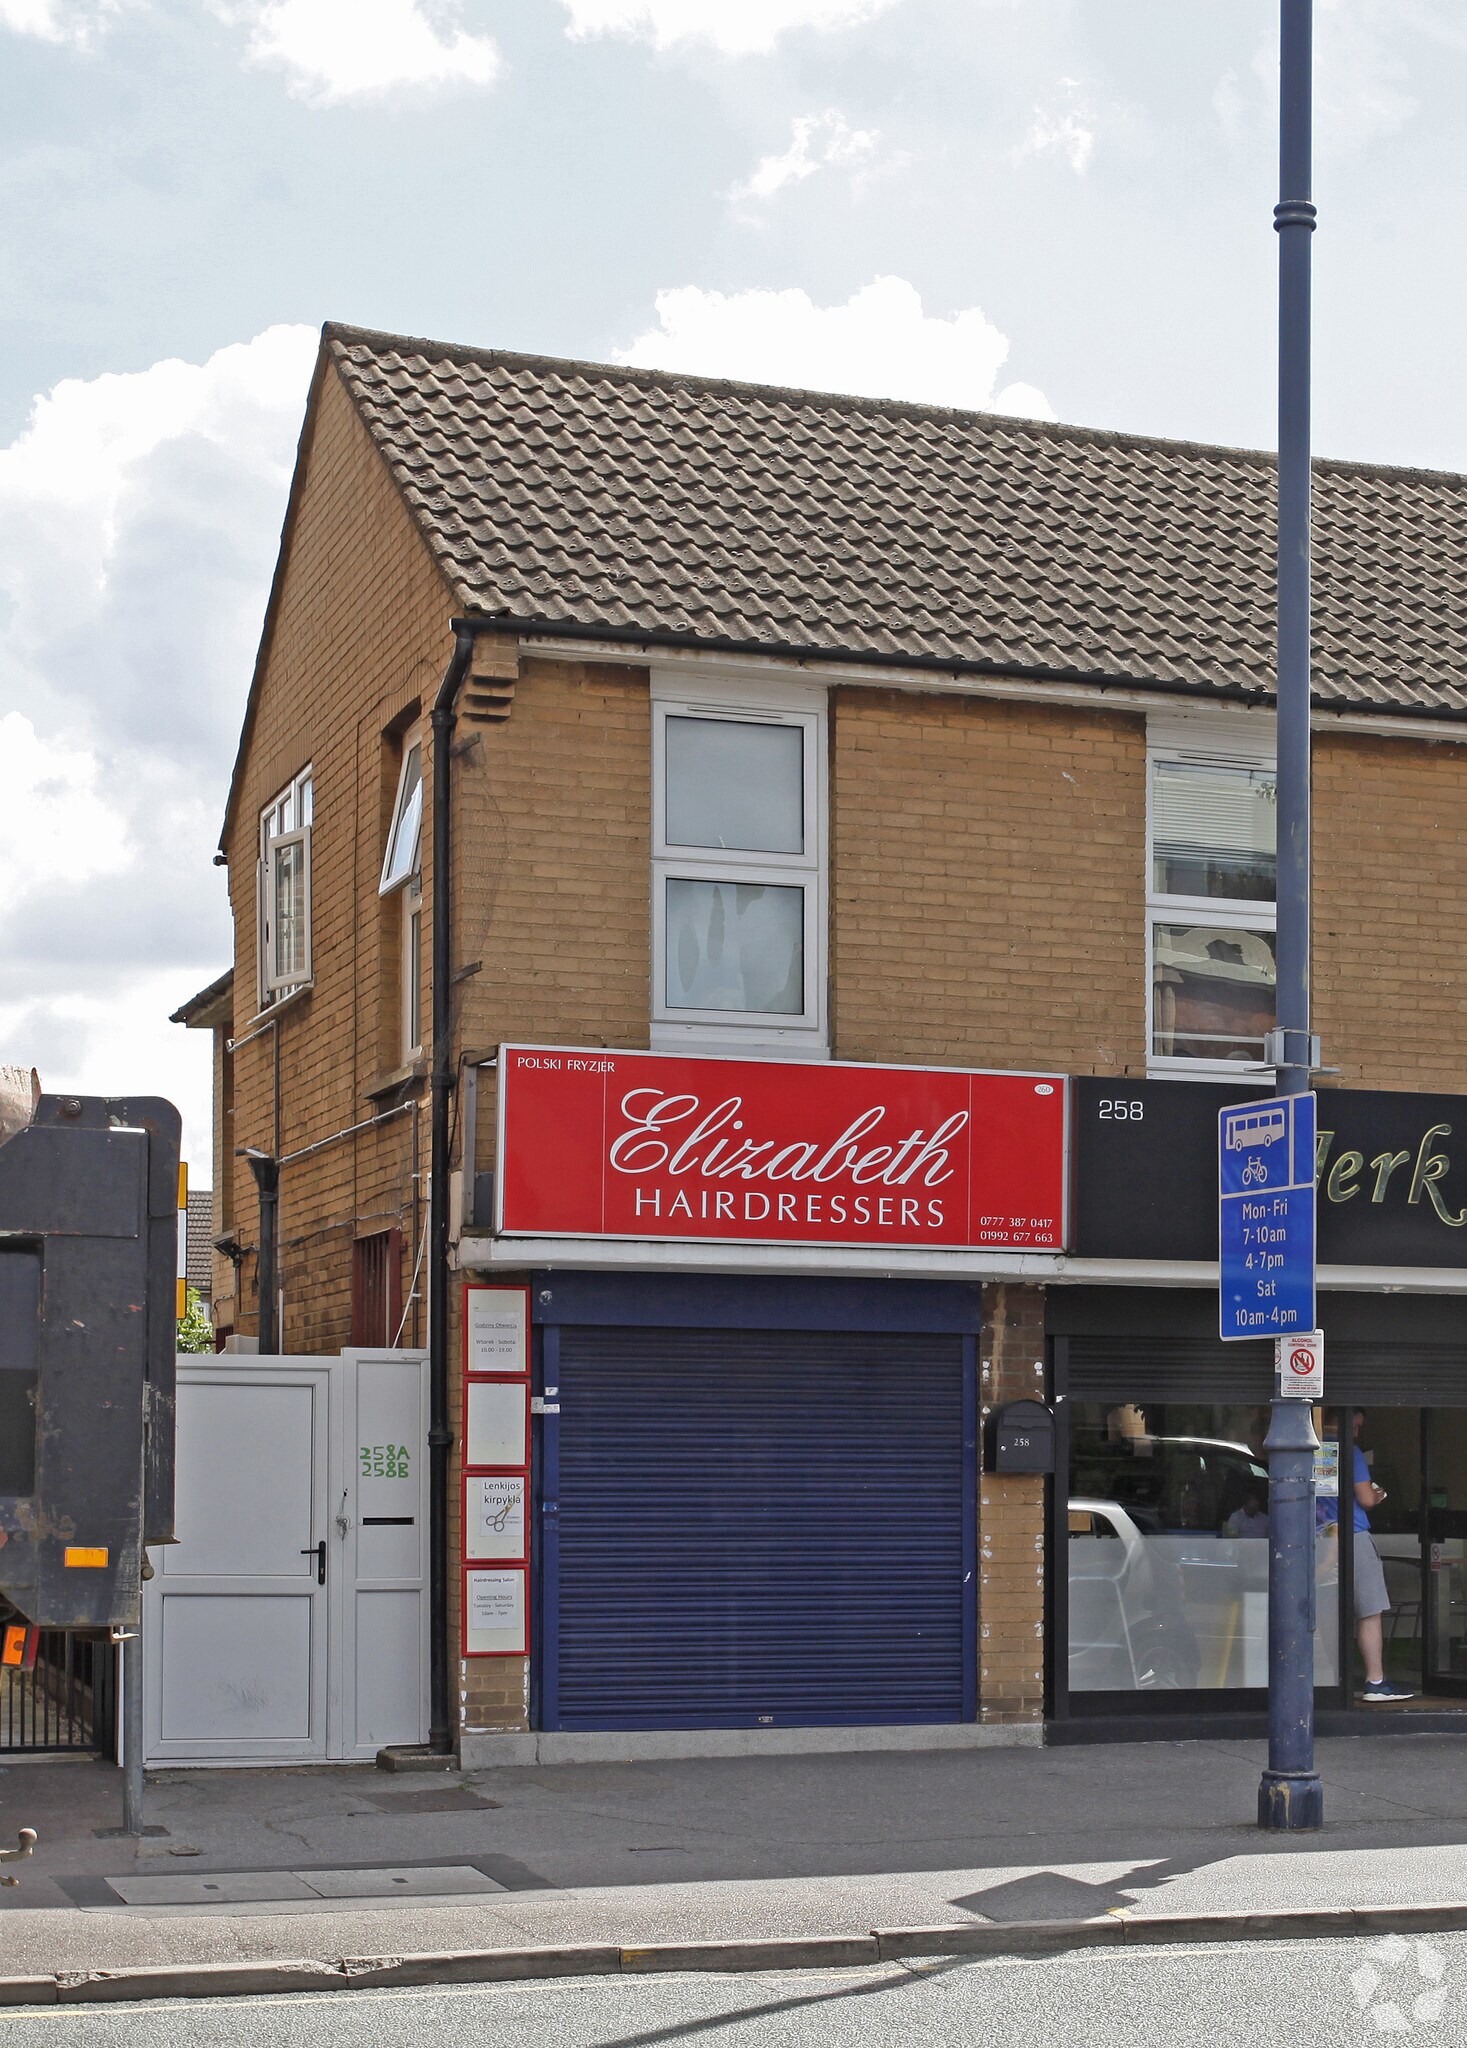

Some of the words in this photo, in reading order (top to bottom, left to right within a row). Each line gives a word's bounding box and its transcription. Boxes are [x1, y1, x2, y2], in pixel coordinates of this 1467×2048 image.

[517, 1057, 561, 1070] POLSKI
[567, 1059, 615, 1072] FRYZJER
[1098, 1099, 1144, 1121] 258
[609, 1087, 969, 1187] Elizabeth
[634, 1188, 945, 1227] HAIRDRESSERS
[980, 1216, 1005, 1226] 0777
[1009, 1217, 1027, 1227] 387
[1030, 1218, 1053, 1228] 0417
[980, 1230, 1009, 1241] 01992
[1013, 1231, 1031, 1242] 677
[1035, 1232, 1053, 1243] 663
[1243, 1226, 1286, 1245] 7-10am
[1245, 1252, 1284, 1271] 4-7pm
[1257, 1279, 1276, 1298] Sat
[1235, 1307, 1297, 1327] 10am-4pm
[1013, 1438, 1030, 1447] 258
[359, 1444, 411, 1461] 258A
[361, 1460, 409, 1478] 258B
[484, 1481, 521, 1491] Lenkijos
